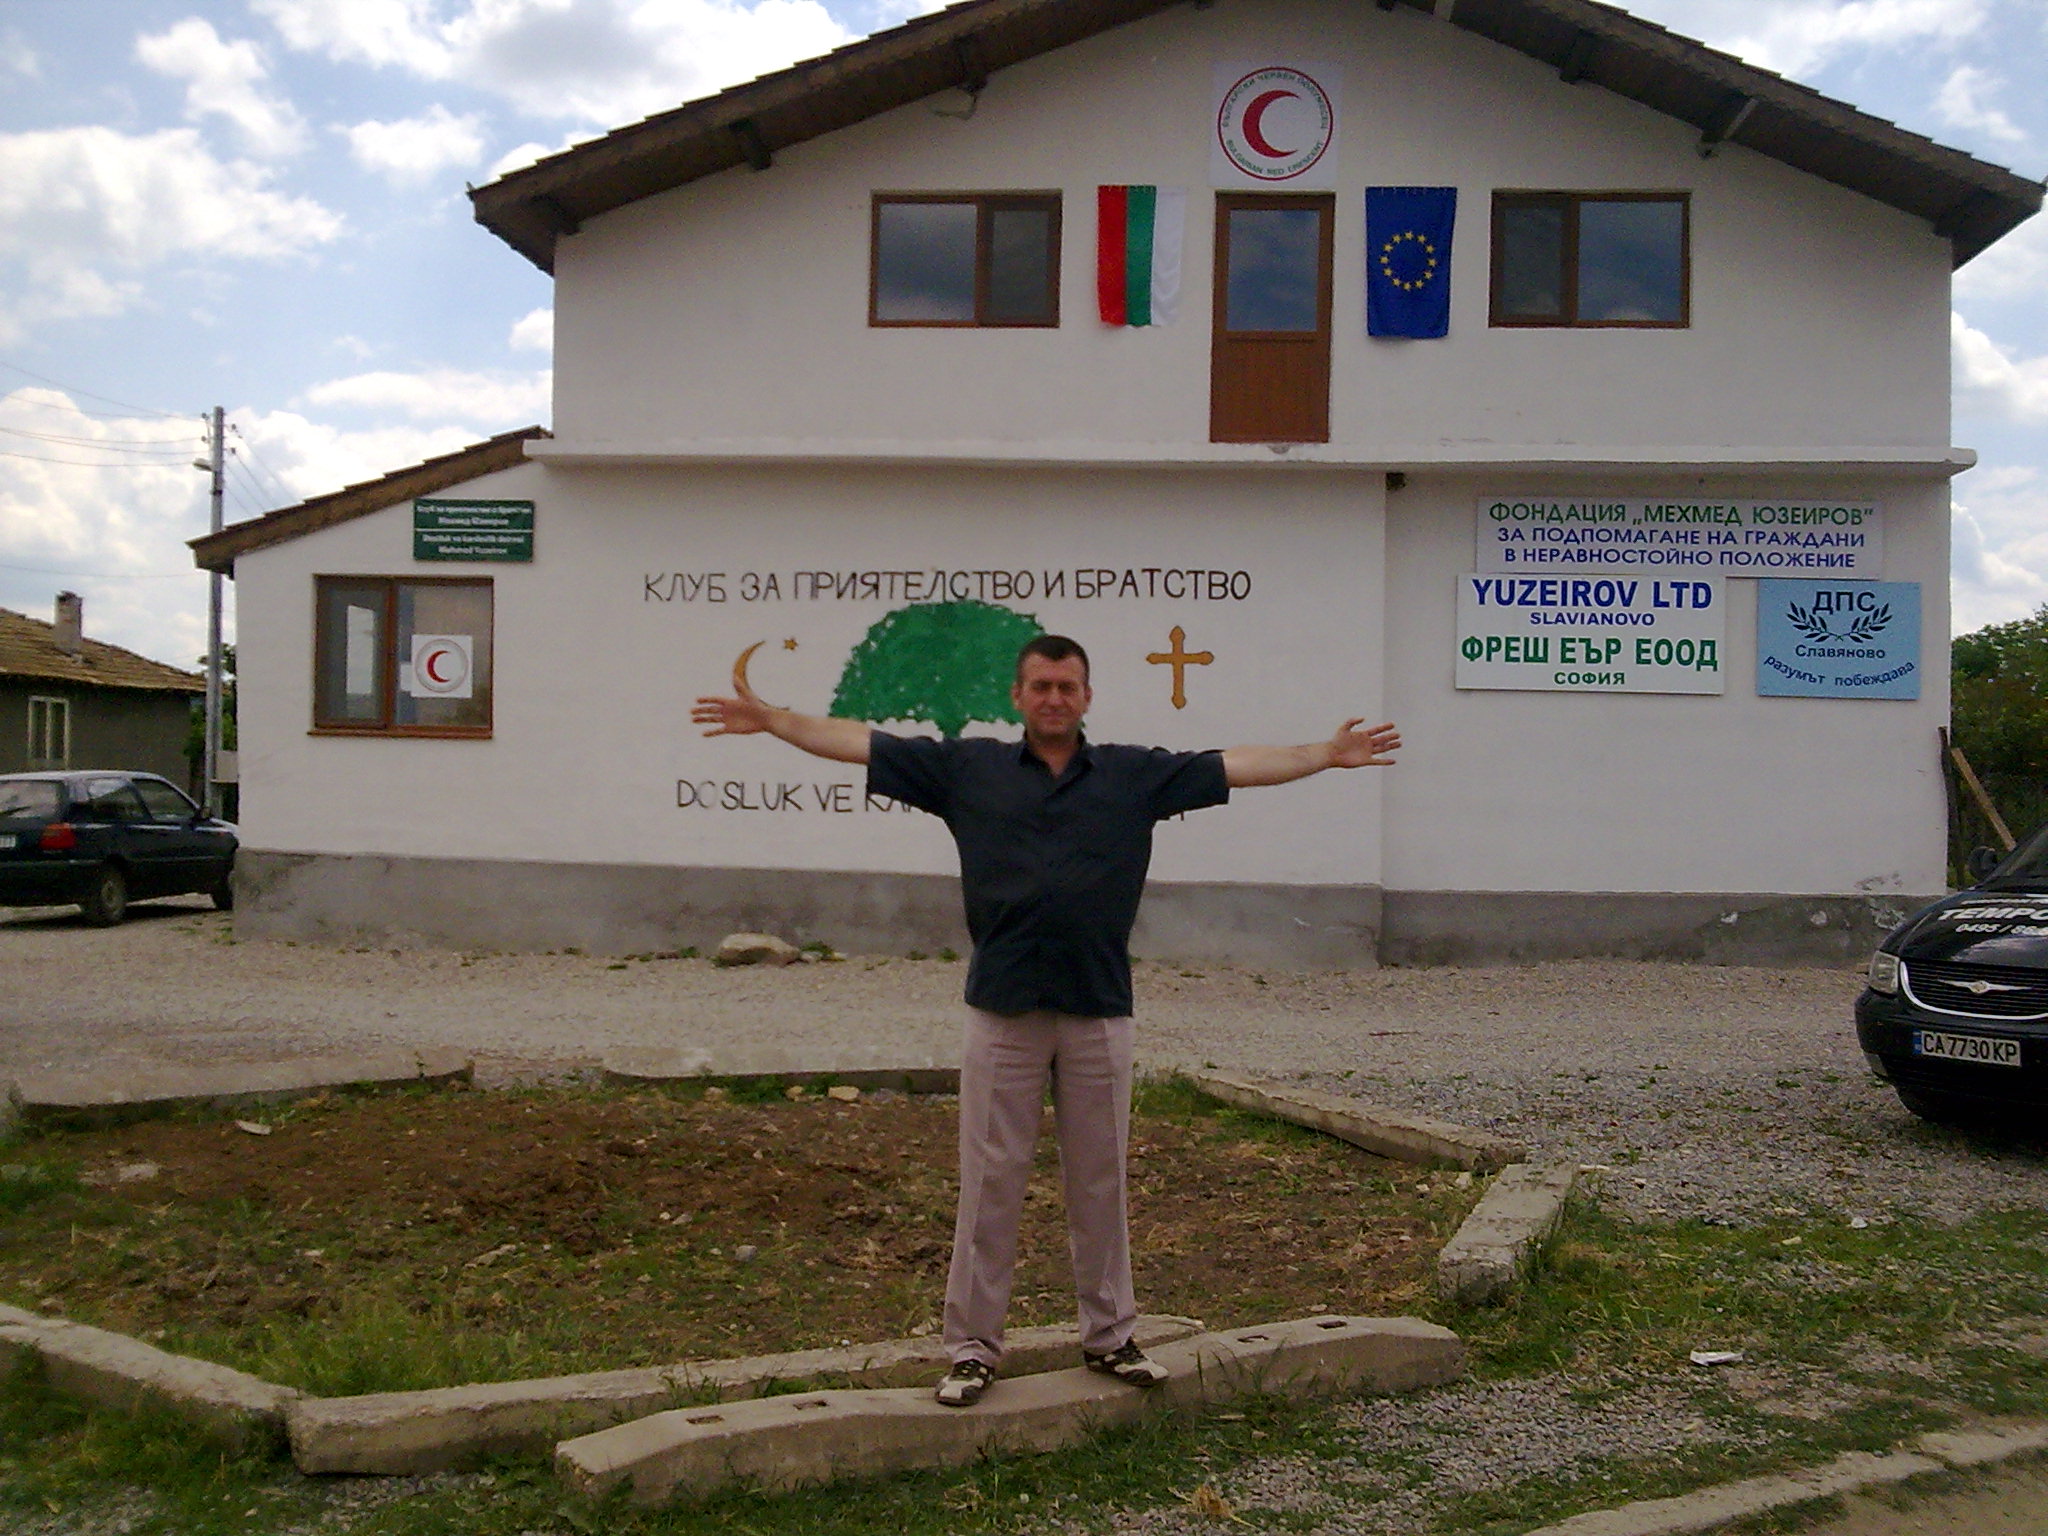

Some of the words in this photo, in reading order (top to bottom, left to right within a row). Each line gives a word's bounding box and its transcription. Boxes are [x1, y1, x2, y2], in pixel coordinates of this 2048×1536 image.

[1489, 502, 1626, 524] ФОНДАЦИЯ
[1632, 504, 1742, 527] „МЕХМЕД
[1498, 527, 1525, 542] ЗА
[1532, 527, 1700, 545] ПОДПОМАГАНЕ
[1707, 531, 1738, 545] НА
[1745, 531, 1865, 549] ГРАЖДАНИ
[1505, 549, 1516, 562] В
[1523, 548, 1713, 566] НЕРАВНОСТОЙНО
[1719, 551, 1856, 568] ПОЛОЖЕНИЕ
[644, 572, 727, 603] КЛУБ
[741, 572, 781, 601] ЗА
[793, 569, 1035, 601] ПРИЯТЕЛСТВО
[1044, 571, 1065, 599] И
[1075, 568, 1251, 600] БРАТСТВО
[1472, 579, 1638, 607] YUZEIROV
[1653, 581, 1713, 609] LTD
[1812, 591, 1876, 615] ДПС
[1529, 612, 1656, 626] SLAVIANOVO
[1461, 636, 1549, 663] ФРЕШ
[1560, 637, 1622, 665] ЕЪР
[1635, 638, 1718, 672] ЕООД
[1795, 644, 1886, 659] Славяново
[1554, 672, 1626, 686] СОФИЯ
[1763, 655, 1826, 685] разумът
[1834, 661, 1915, 687] побеждава
[812, 784, 852, 812] VE
